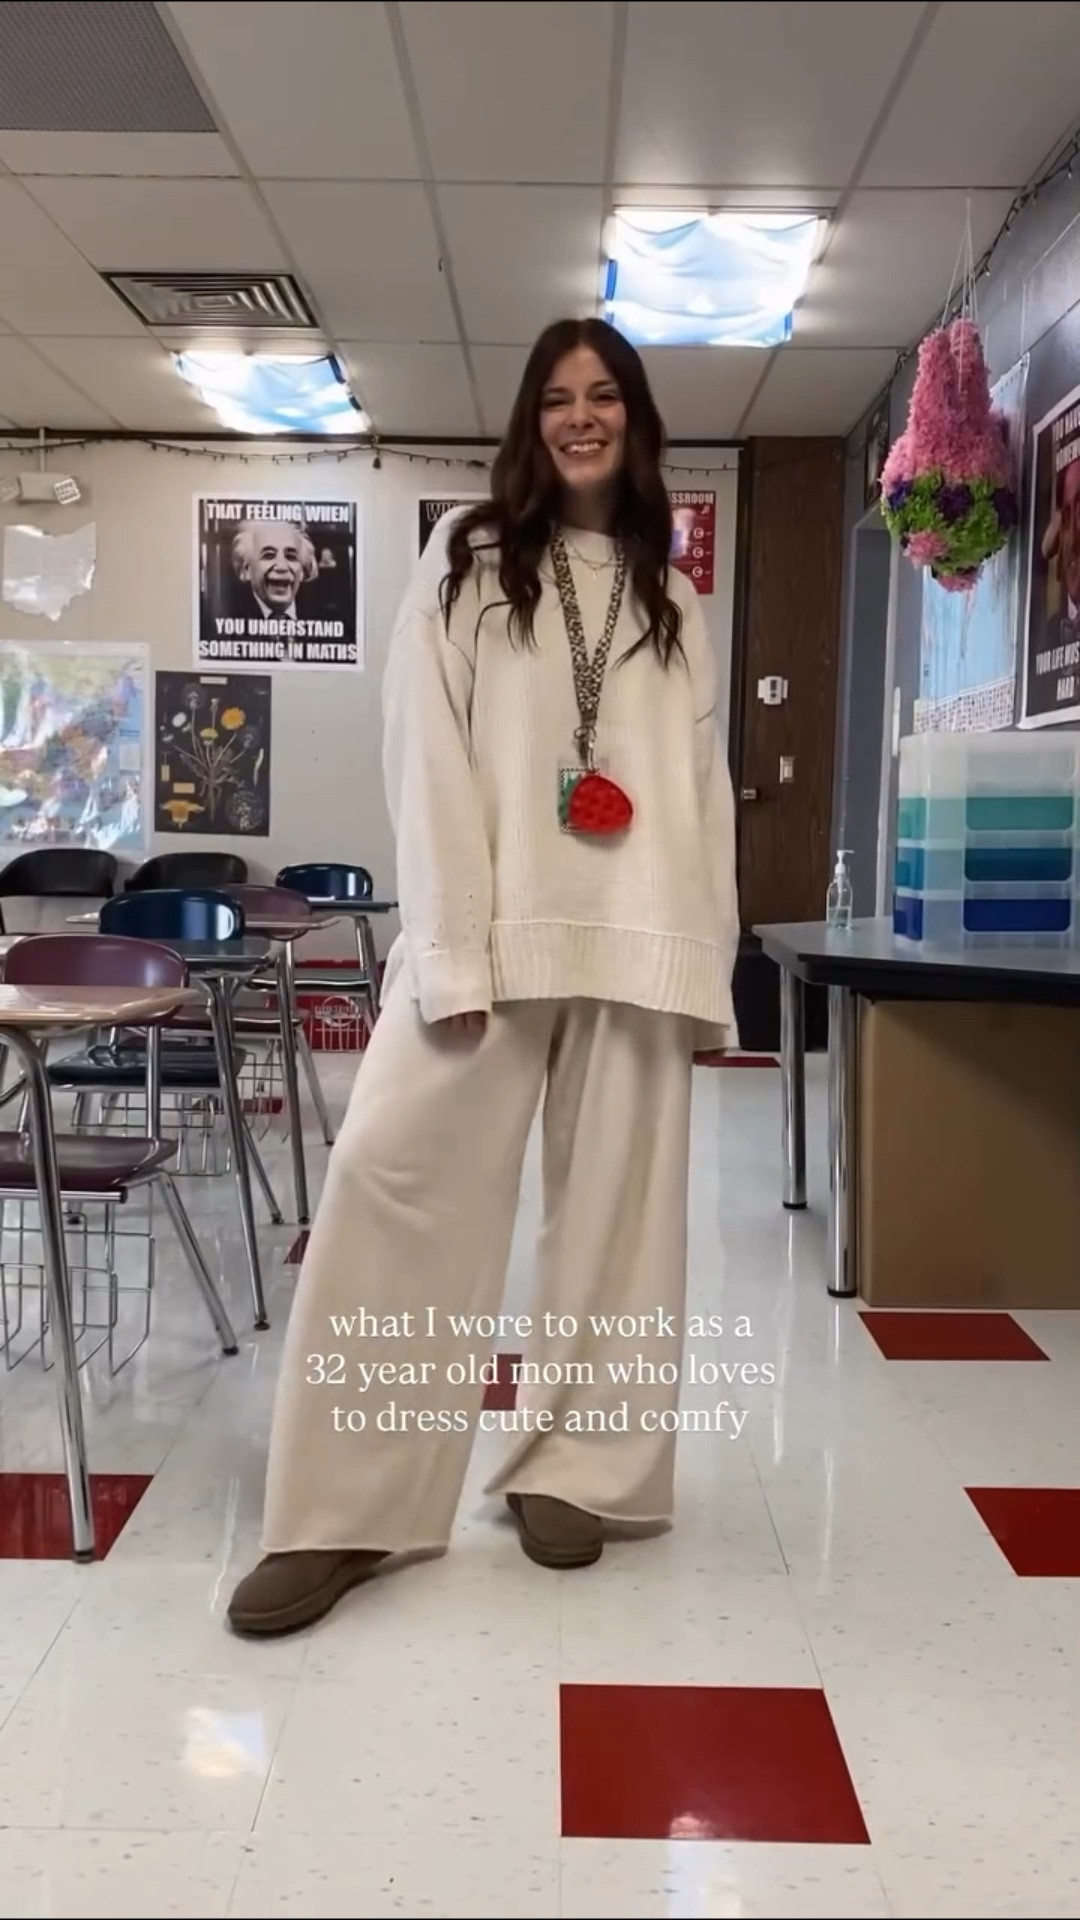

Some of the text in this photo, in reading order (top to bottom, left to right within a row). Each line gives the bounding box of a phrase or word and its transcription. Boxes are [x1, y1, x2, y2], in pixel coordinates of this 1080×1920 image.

[207, 503, 349, 522] THAT FEELING WHEN
[215, 618, 344, 637] YOU UNDERSTAND
[199, 640, 358, 661] SOMETHING IN MATHS
